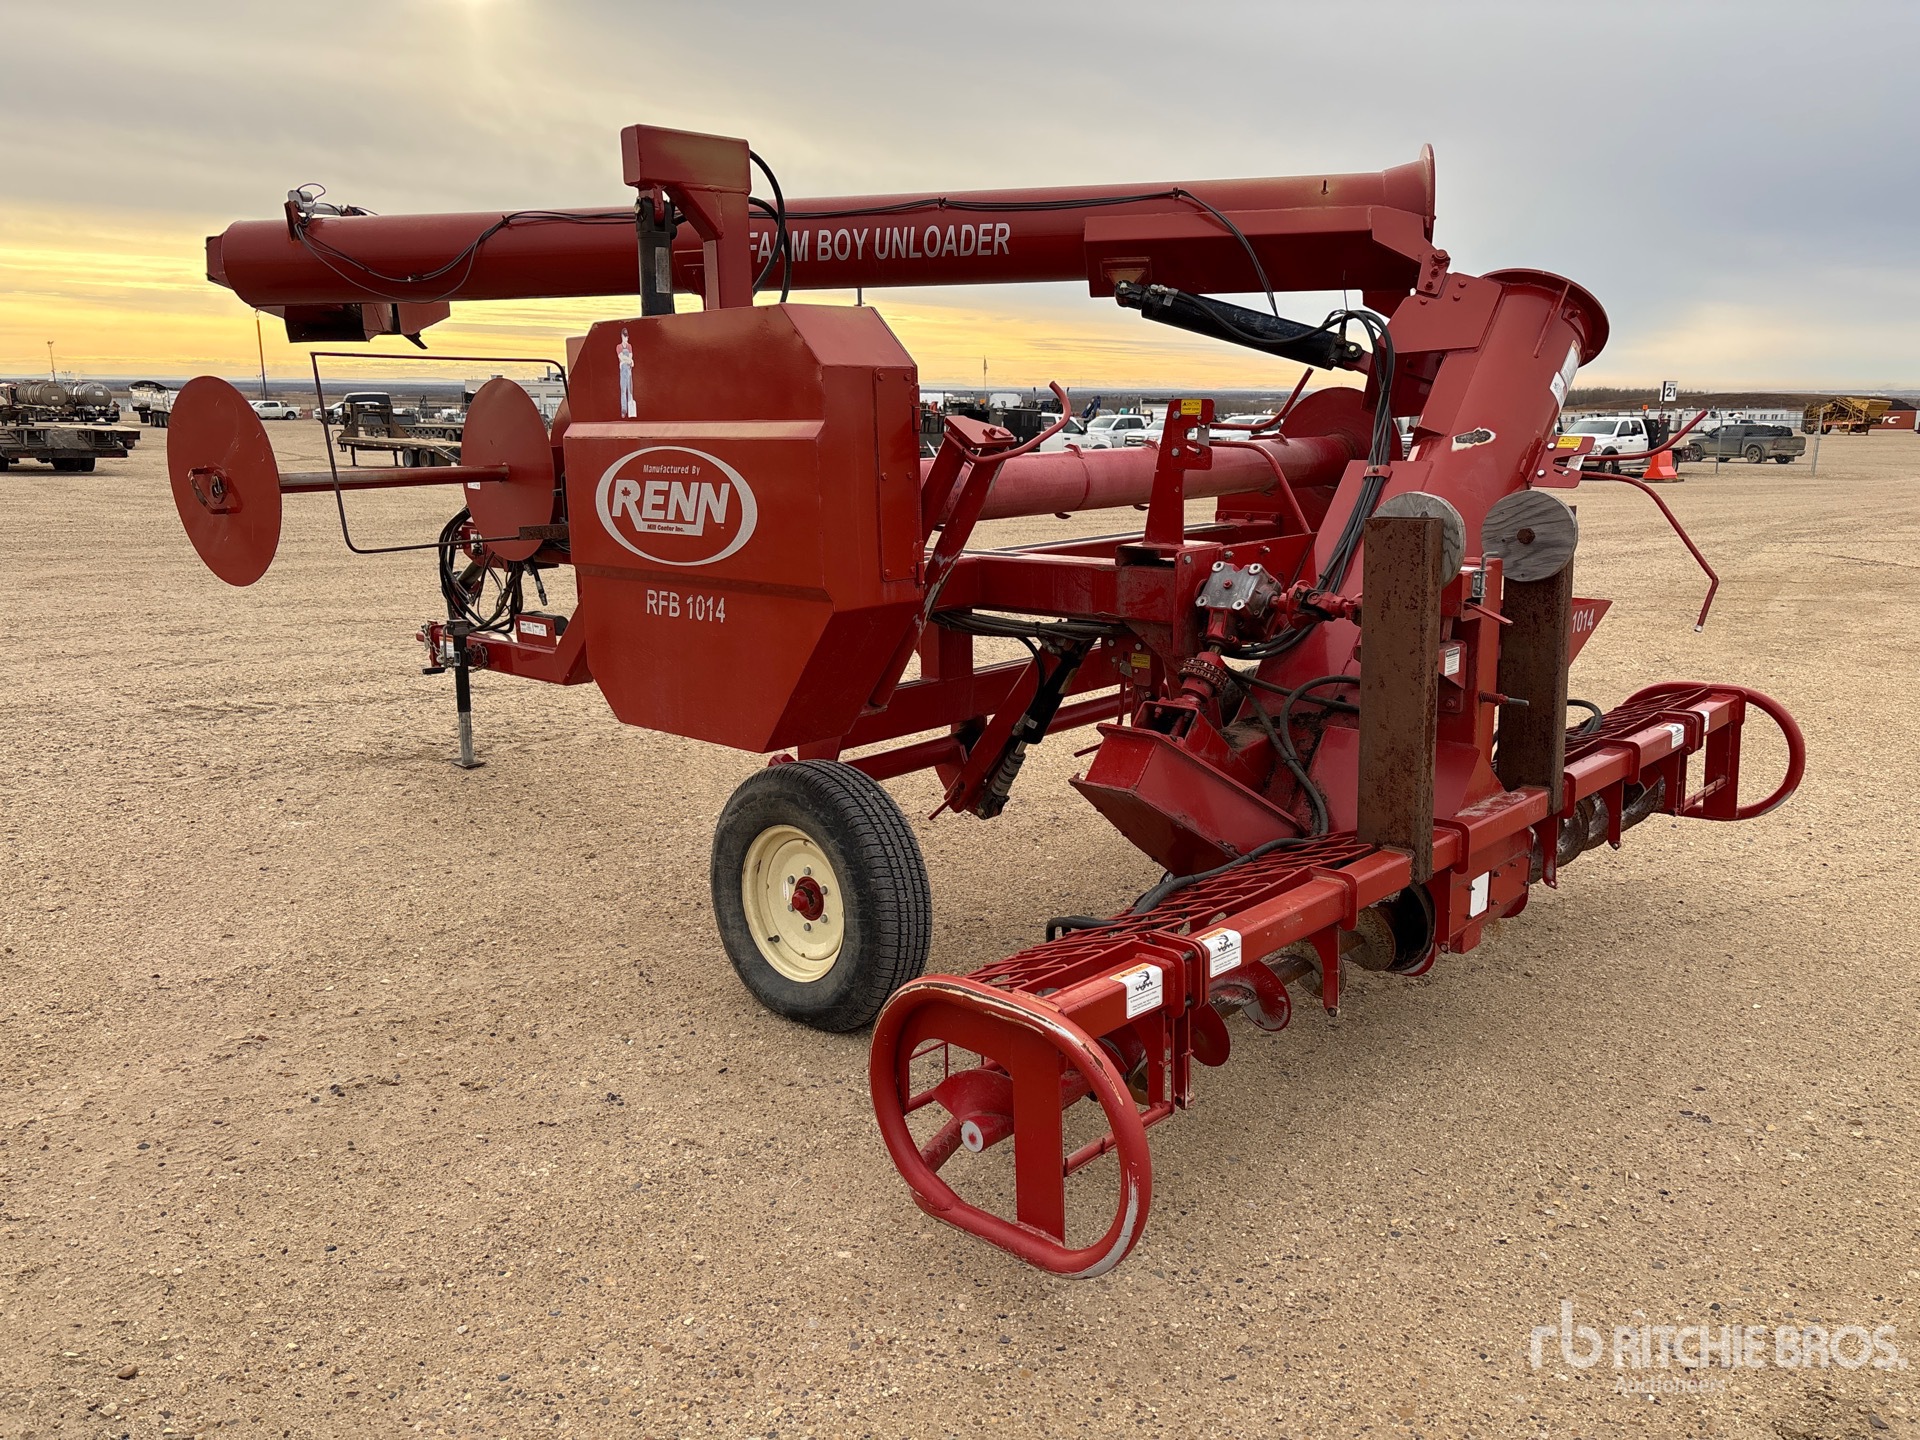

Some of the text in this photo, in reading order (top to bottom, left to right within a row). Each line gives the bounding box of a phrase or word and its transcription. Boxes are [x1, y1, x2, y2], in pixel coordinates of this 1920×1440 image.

[816, 227, 869, 262] BOY
[875, 222, 1012, 260] UNLOADER
[1665, 386, 1676, 398] 21
[643, 464, 701, 476] Manufactured By
[611, 479, 731, 534] RENN
[647, 523, 657, 531] Mill
[658, 524, 676, 532] Center
[646, 589, 726, 623] RFB 1014
[1572, 608, 1595, 633] 1014
